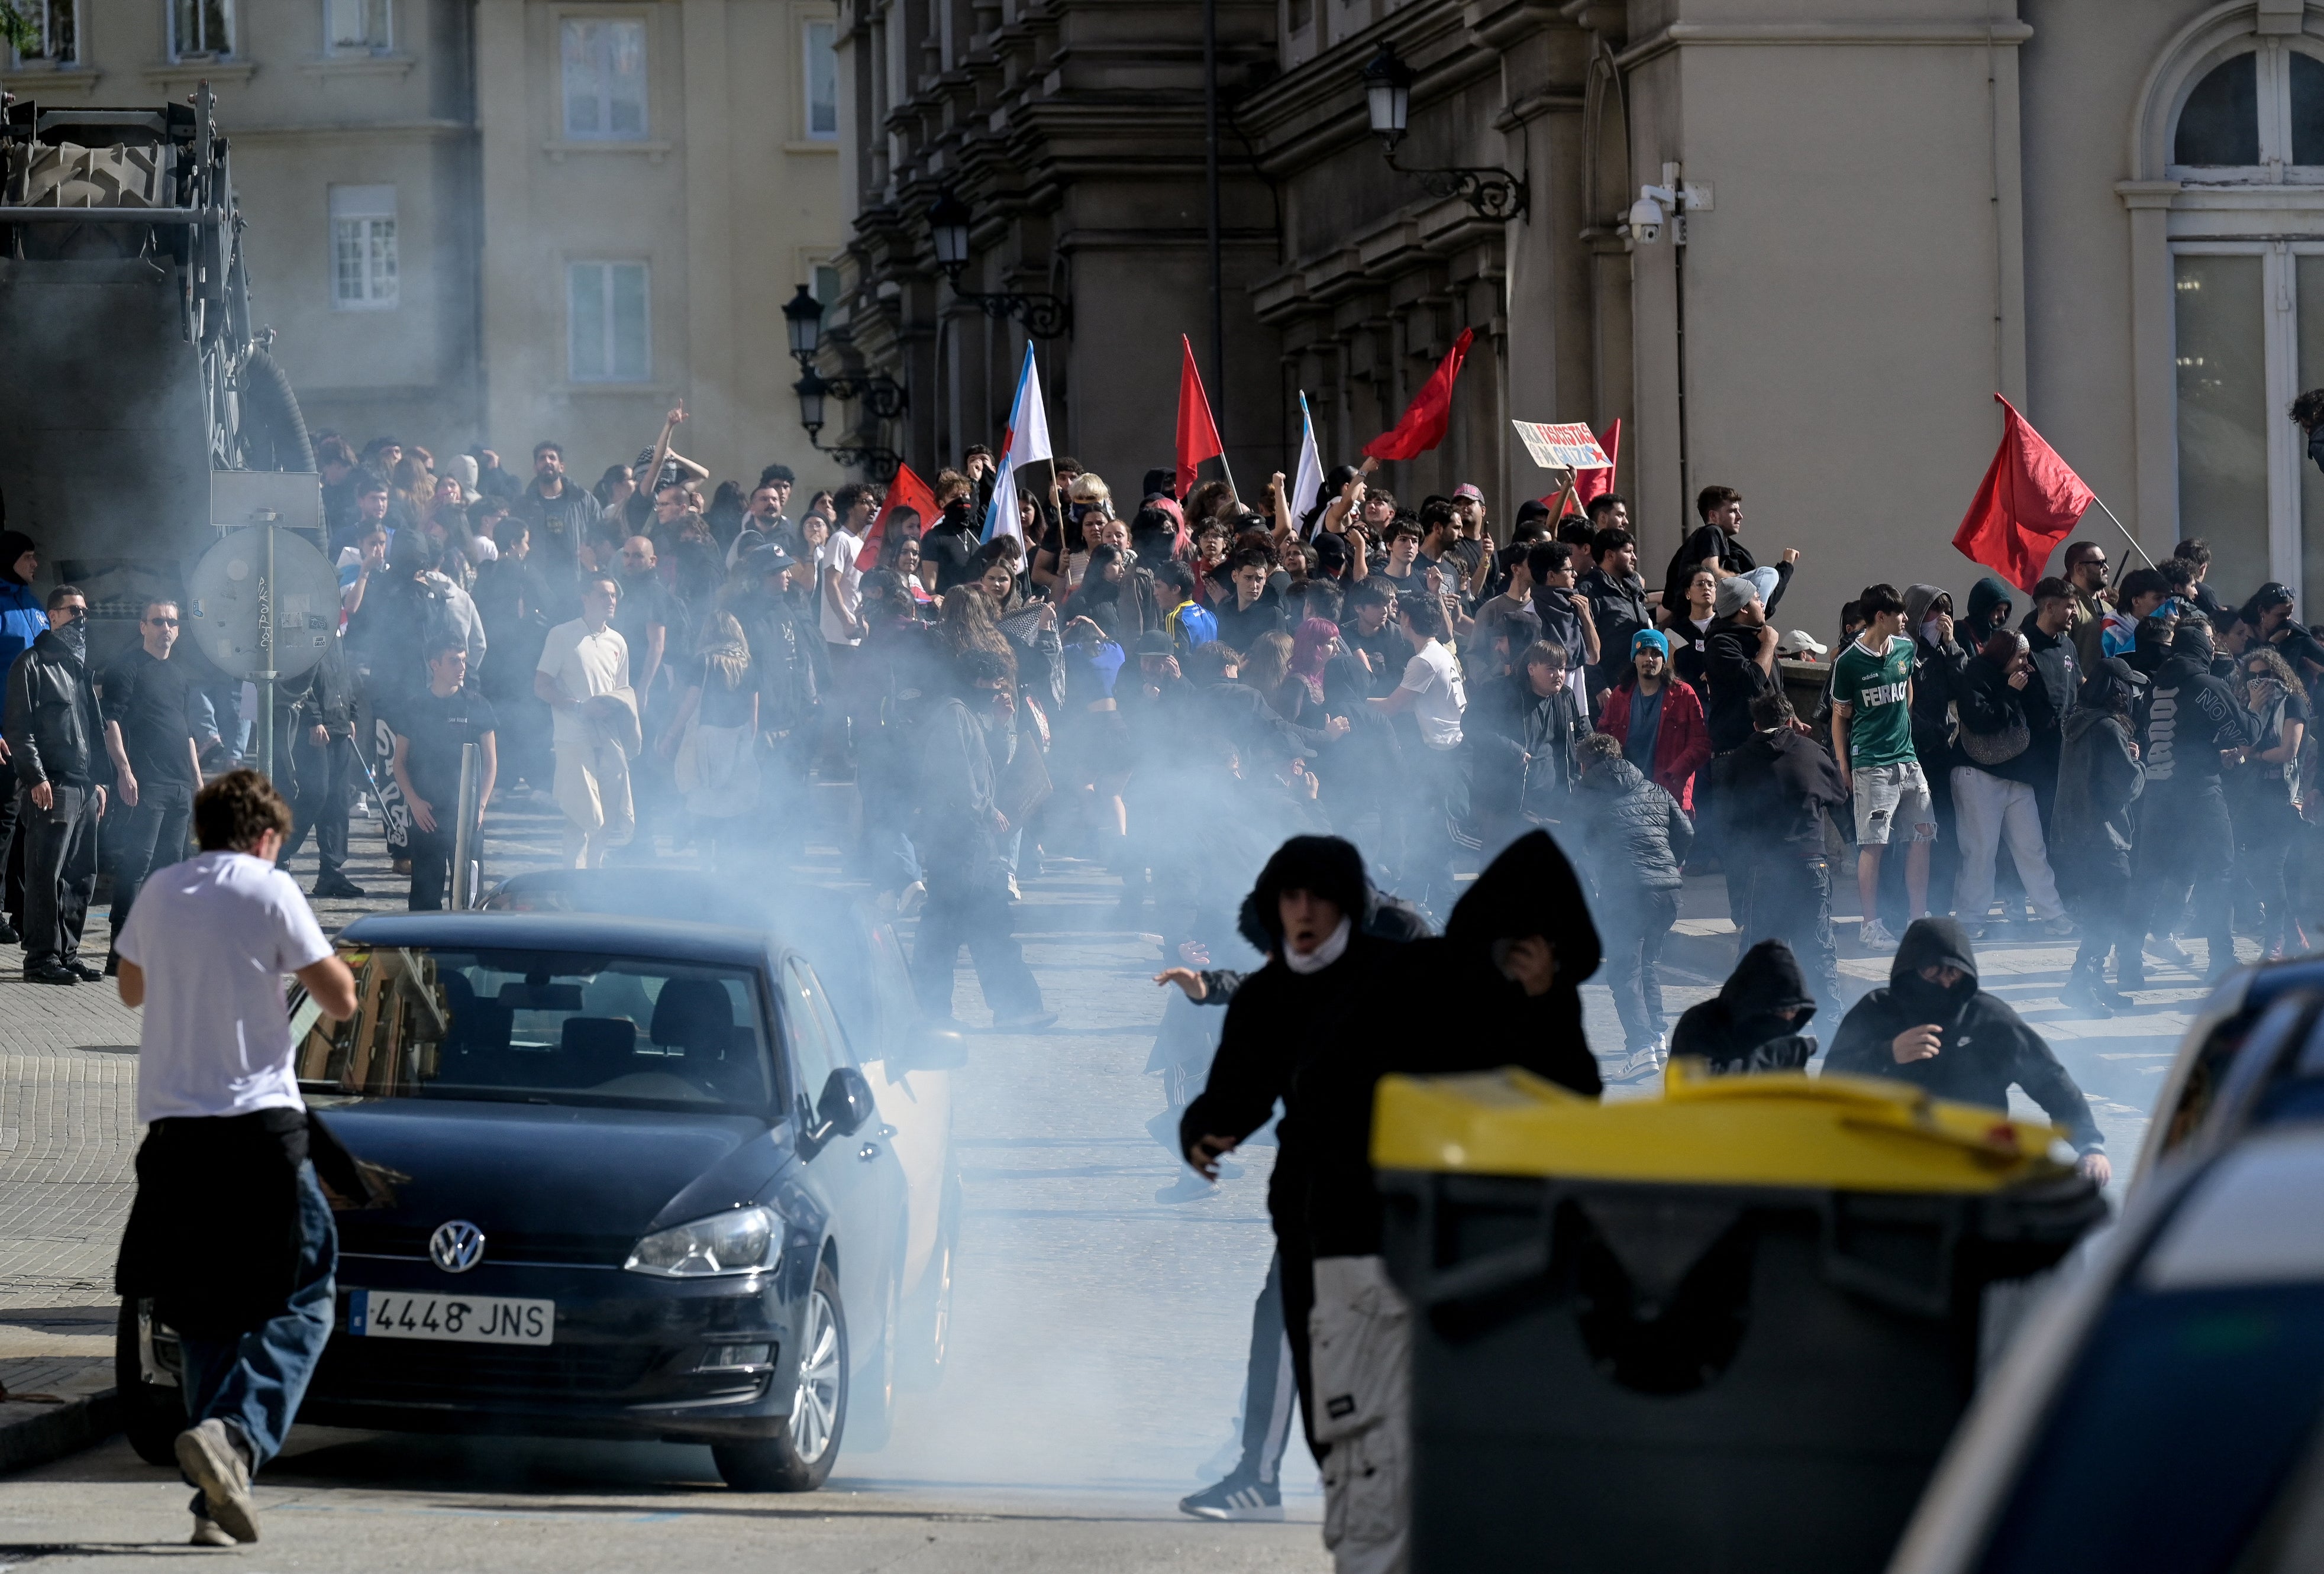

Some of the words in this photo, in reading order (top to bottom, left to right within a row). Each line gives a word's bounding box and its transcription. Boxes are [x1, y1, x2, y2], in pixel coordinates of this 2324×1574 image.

[1515, 422, 1543, 444] FORA
[1536, 424, 1596, 446] FASCISTAS
[1553, 445, 1596, 466] GALIZA
[1861, 673, 1878, 681] adidas
[2195, 687, 2226, 721] NO
[375, 1298, 465, 1333] 4448
[479, 1304, 544, 1337] JNS
